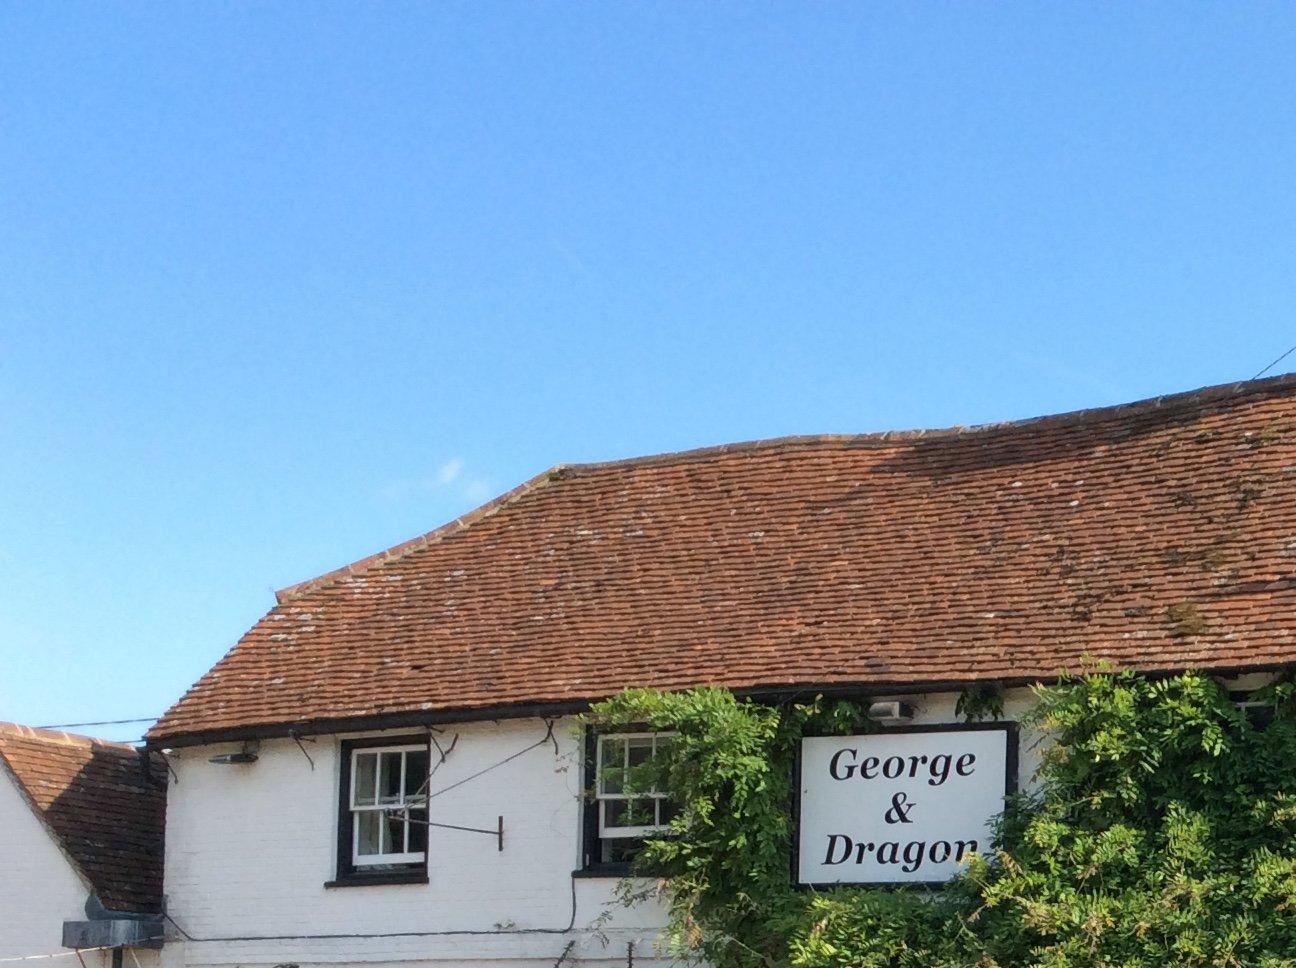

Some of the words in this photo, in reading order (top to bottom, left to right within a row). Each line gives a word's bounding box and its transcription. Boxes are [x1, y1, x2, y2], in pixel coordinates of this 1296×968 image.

[829, 748, 976, 786] George
[884, 791, 916, 824] &
[820, 834, 978, 873] Dragon
